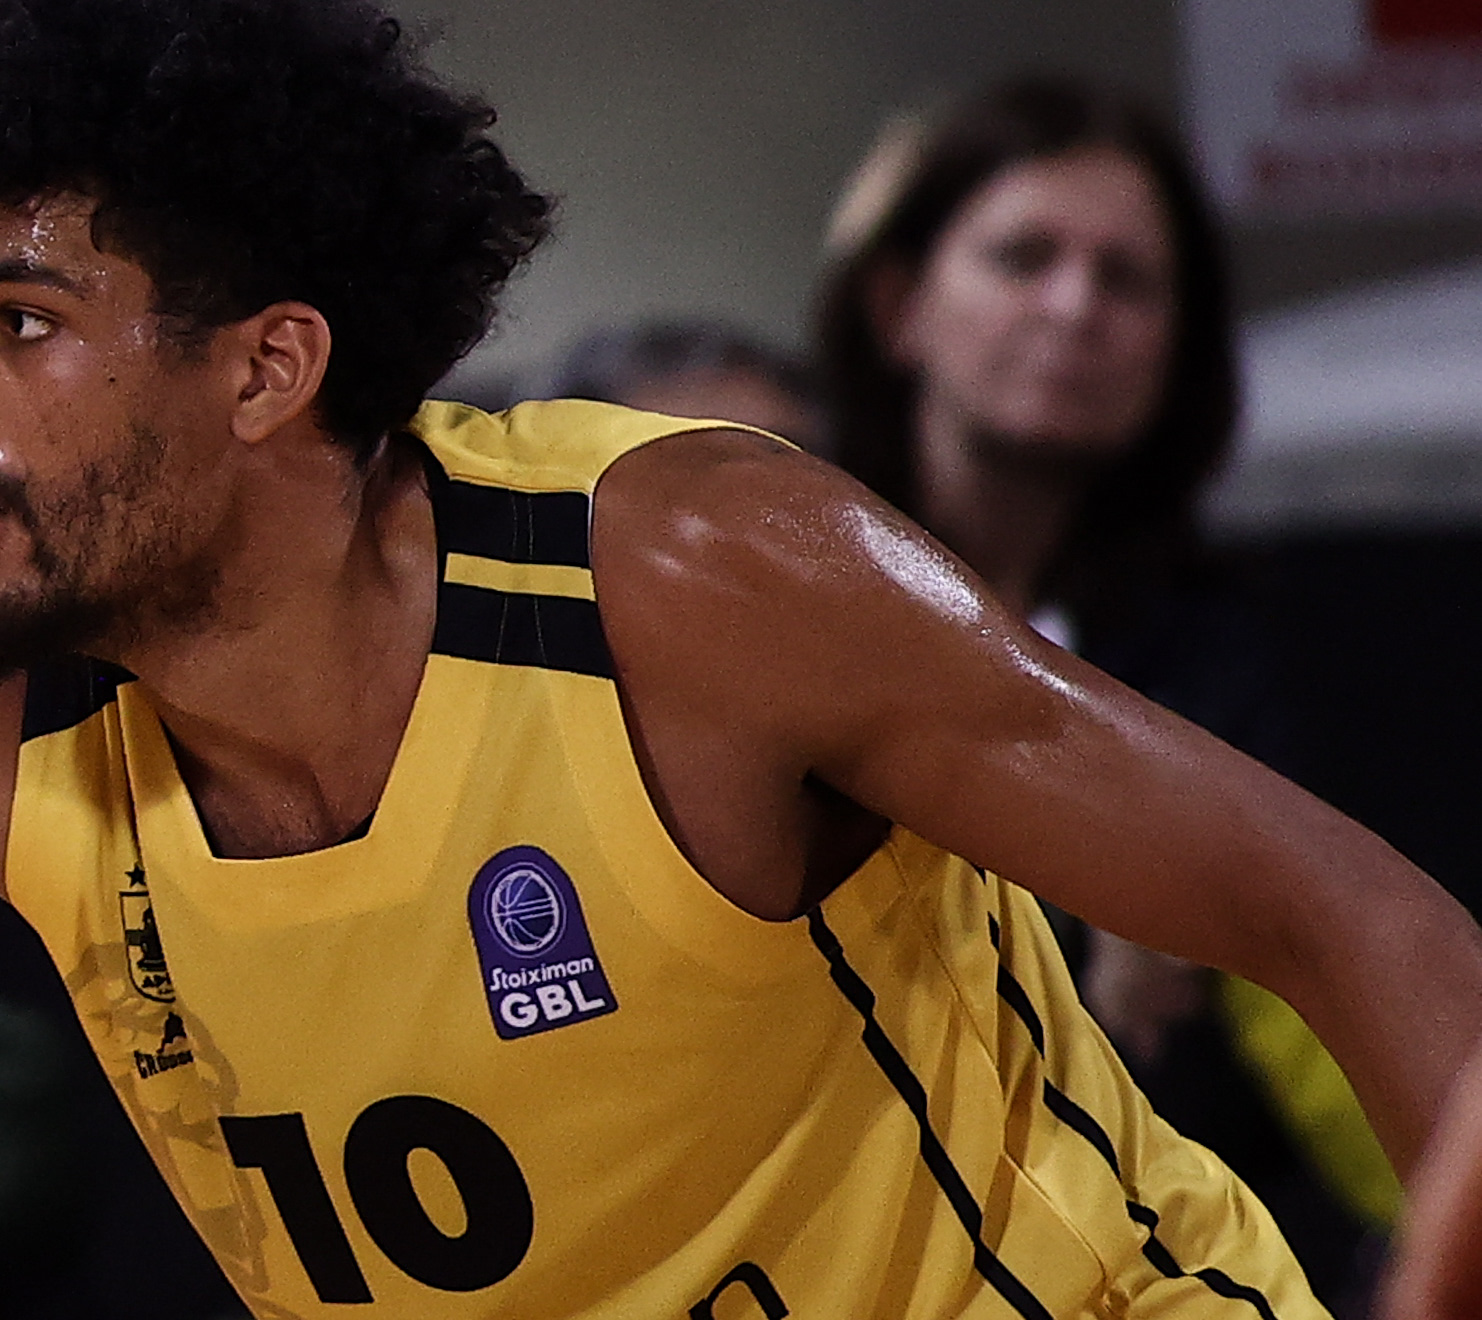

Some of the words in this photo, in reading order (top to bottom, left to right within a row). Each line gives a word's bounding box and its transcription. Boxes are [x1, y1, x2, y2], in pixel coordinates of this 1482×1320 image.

[489, 957, 595, 992] Stoiximan
[500, 979, 606, 1028] GBL
[217, 1093, 535, 1305] 10
